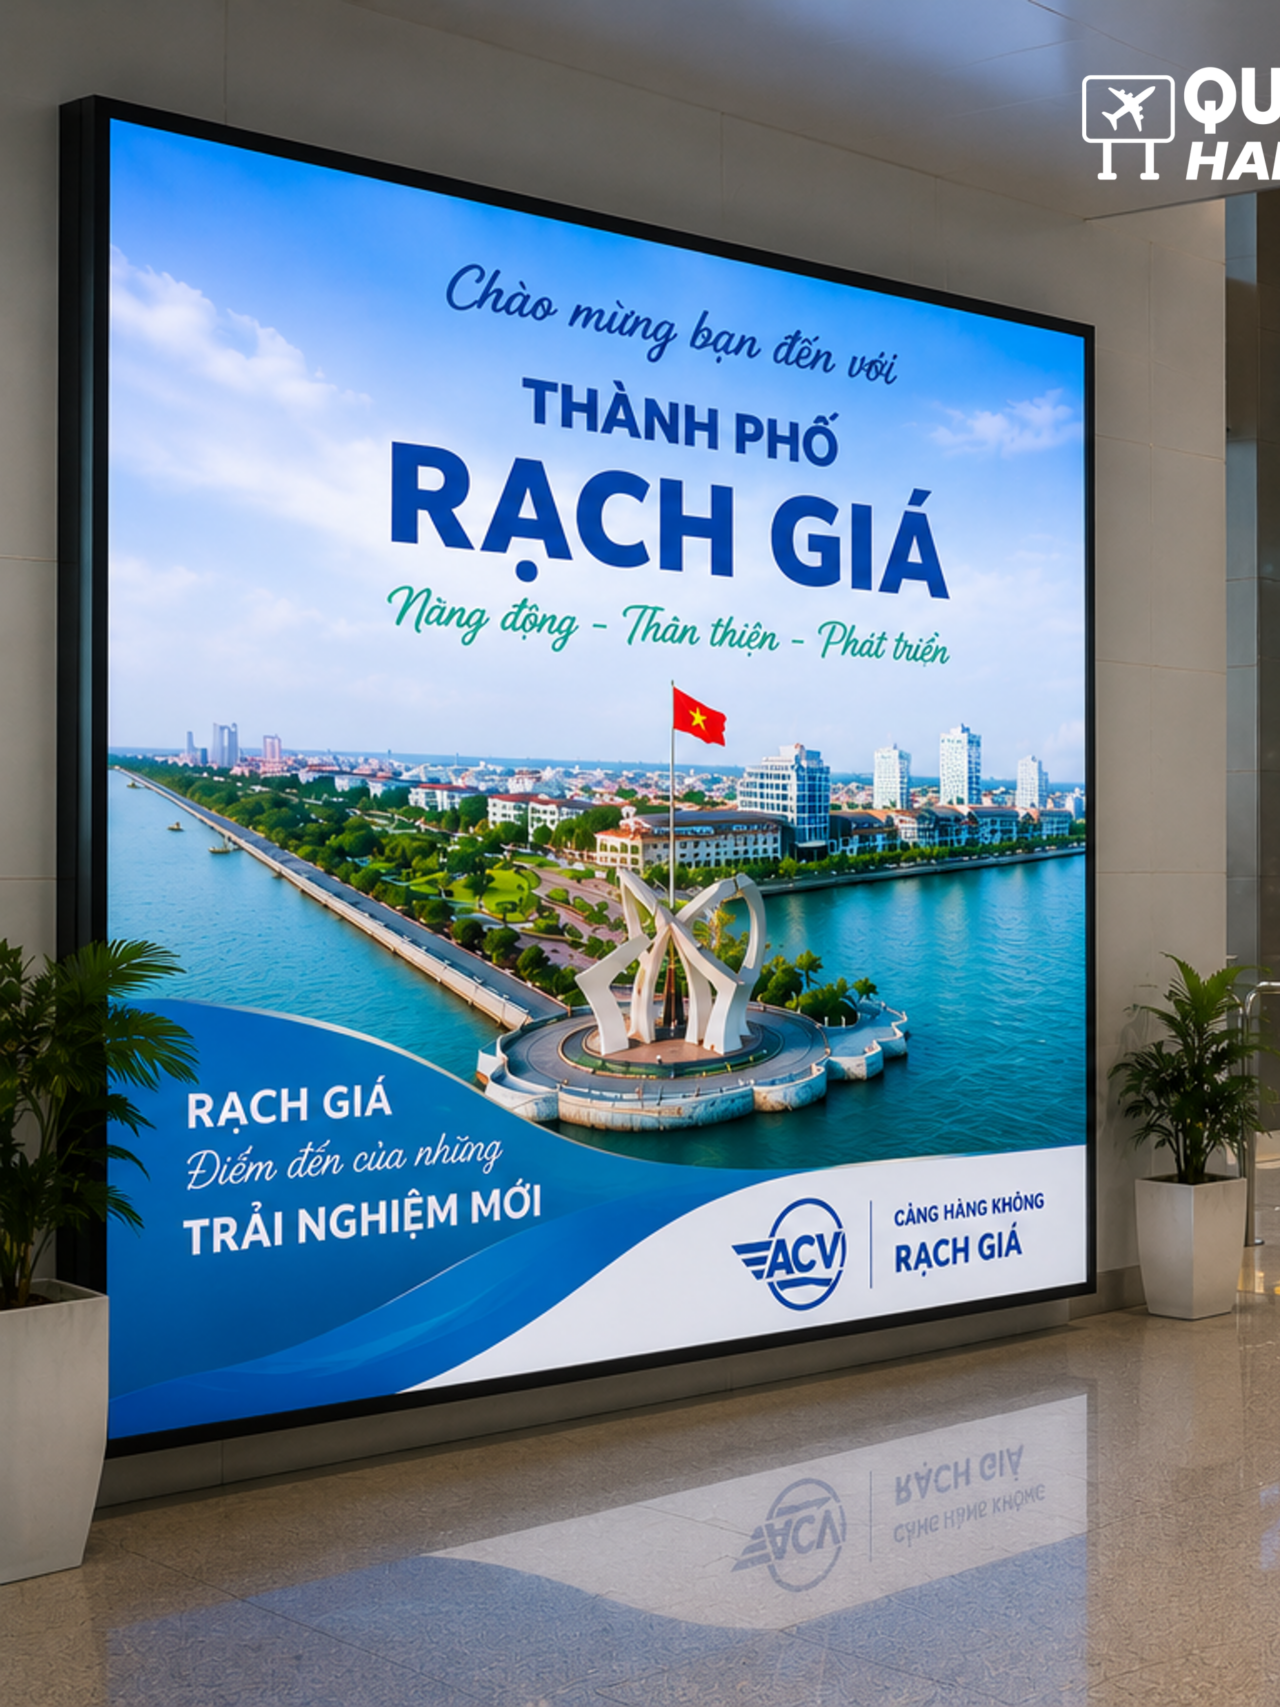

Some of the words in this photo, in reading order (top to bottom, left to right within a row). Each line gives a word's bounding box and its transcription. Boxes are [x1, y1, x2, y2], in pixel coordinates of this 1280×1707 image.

[446, 264, 558, 321] Chào
[568, 300, 677, 362] mừng
[690, 310, 761, 363] bạn
[773, 330, 836, 374] đến
[848, 351, 898, 385] với
[523, 378, 719, 451] THÀNH
[736, 412, 839, 468] PHỐ
[391, 441, 734, 582] RẠCH
[771, 488, 950, 600] GIÁ
[500, 598, 580, 653] động
[622, 604, 701, 646] Thân
[709, 616, 780, 657] thiện
[817, 620, 888, 659] Phát
[188, 1088, 308, 1134] RẠCH
[323, 1075, 393, 1119] GIÁ
[287, 1139, 344, 1179] đến
[353, 1141, 407, 1173] của
[183, 1202, 283, 1256] TRẢI
[298, 1188, 458, 1244] NGHIỆM
[471, 1178, 541, 1224] MỚI
[766, 1230, 844, 1279] ACV
[895, 1235, 970, 1277] RẠCH
[977, 1221, 1023, 1261] GIÁ
